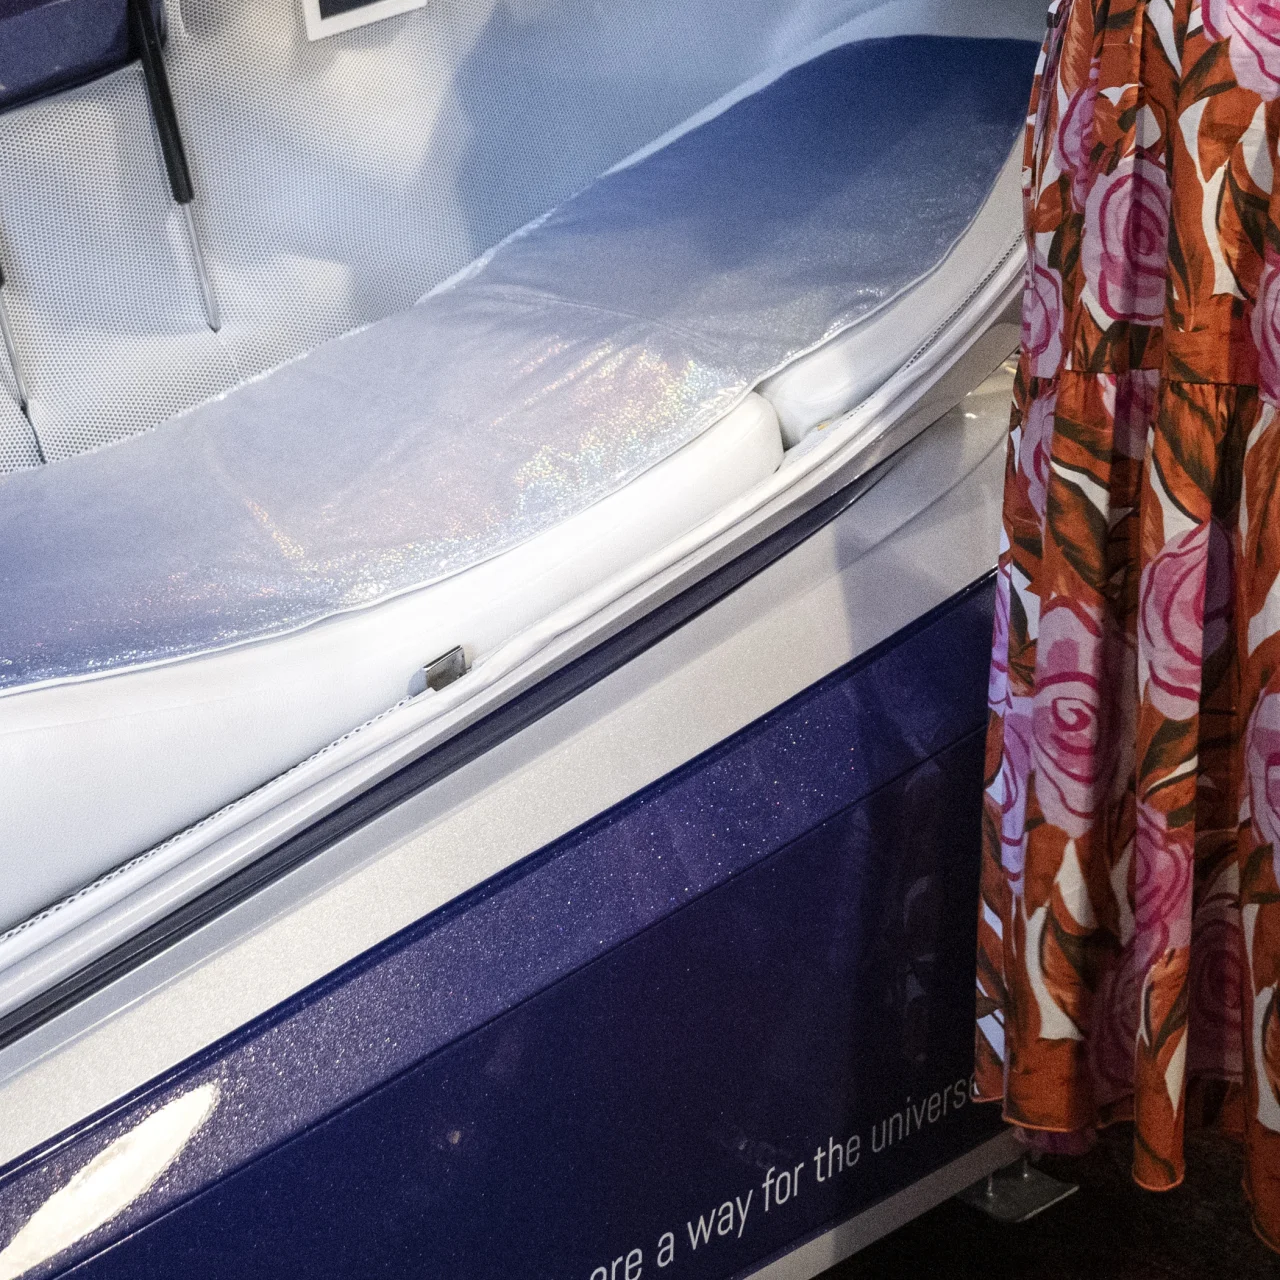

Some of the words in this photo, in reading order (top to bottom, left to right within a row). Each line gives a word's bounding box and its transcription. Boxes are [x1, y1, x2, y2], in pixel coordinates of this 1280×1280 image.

[657, 1231, 675, 1268] a
[687, 1189, 753, 1250] way
[762, 1162, 805, 1212] for
[814, 1136, 861, 1182] the
